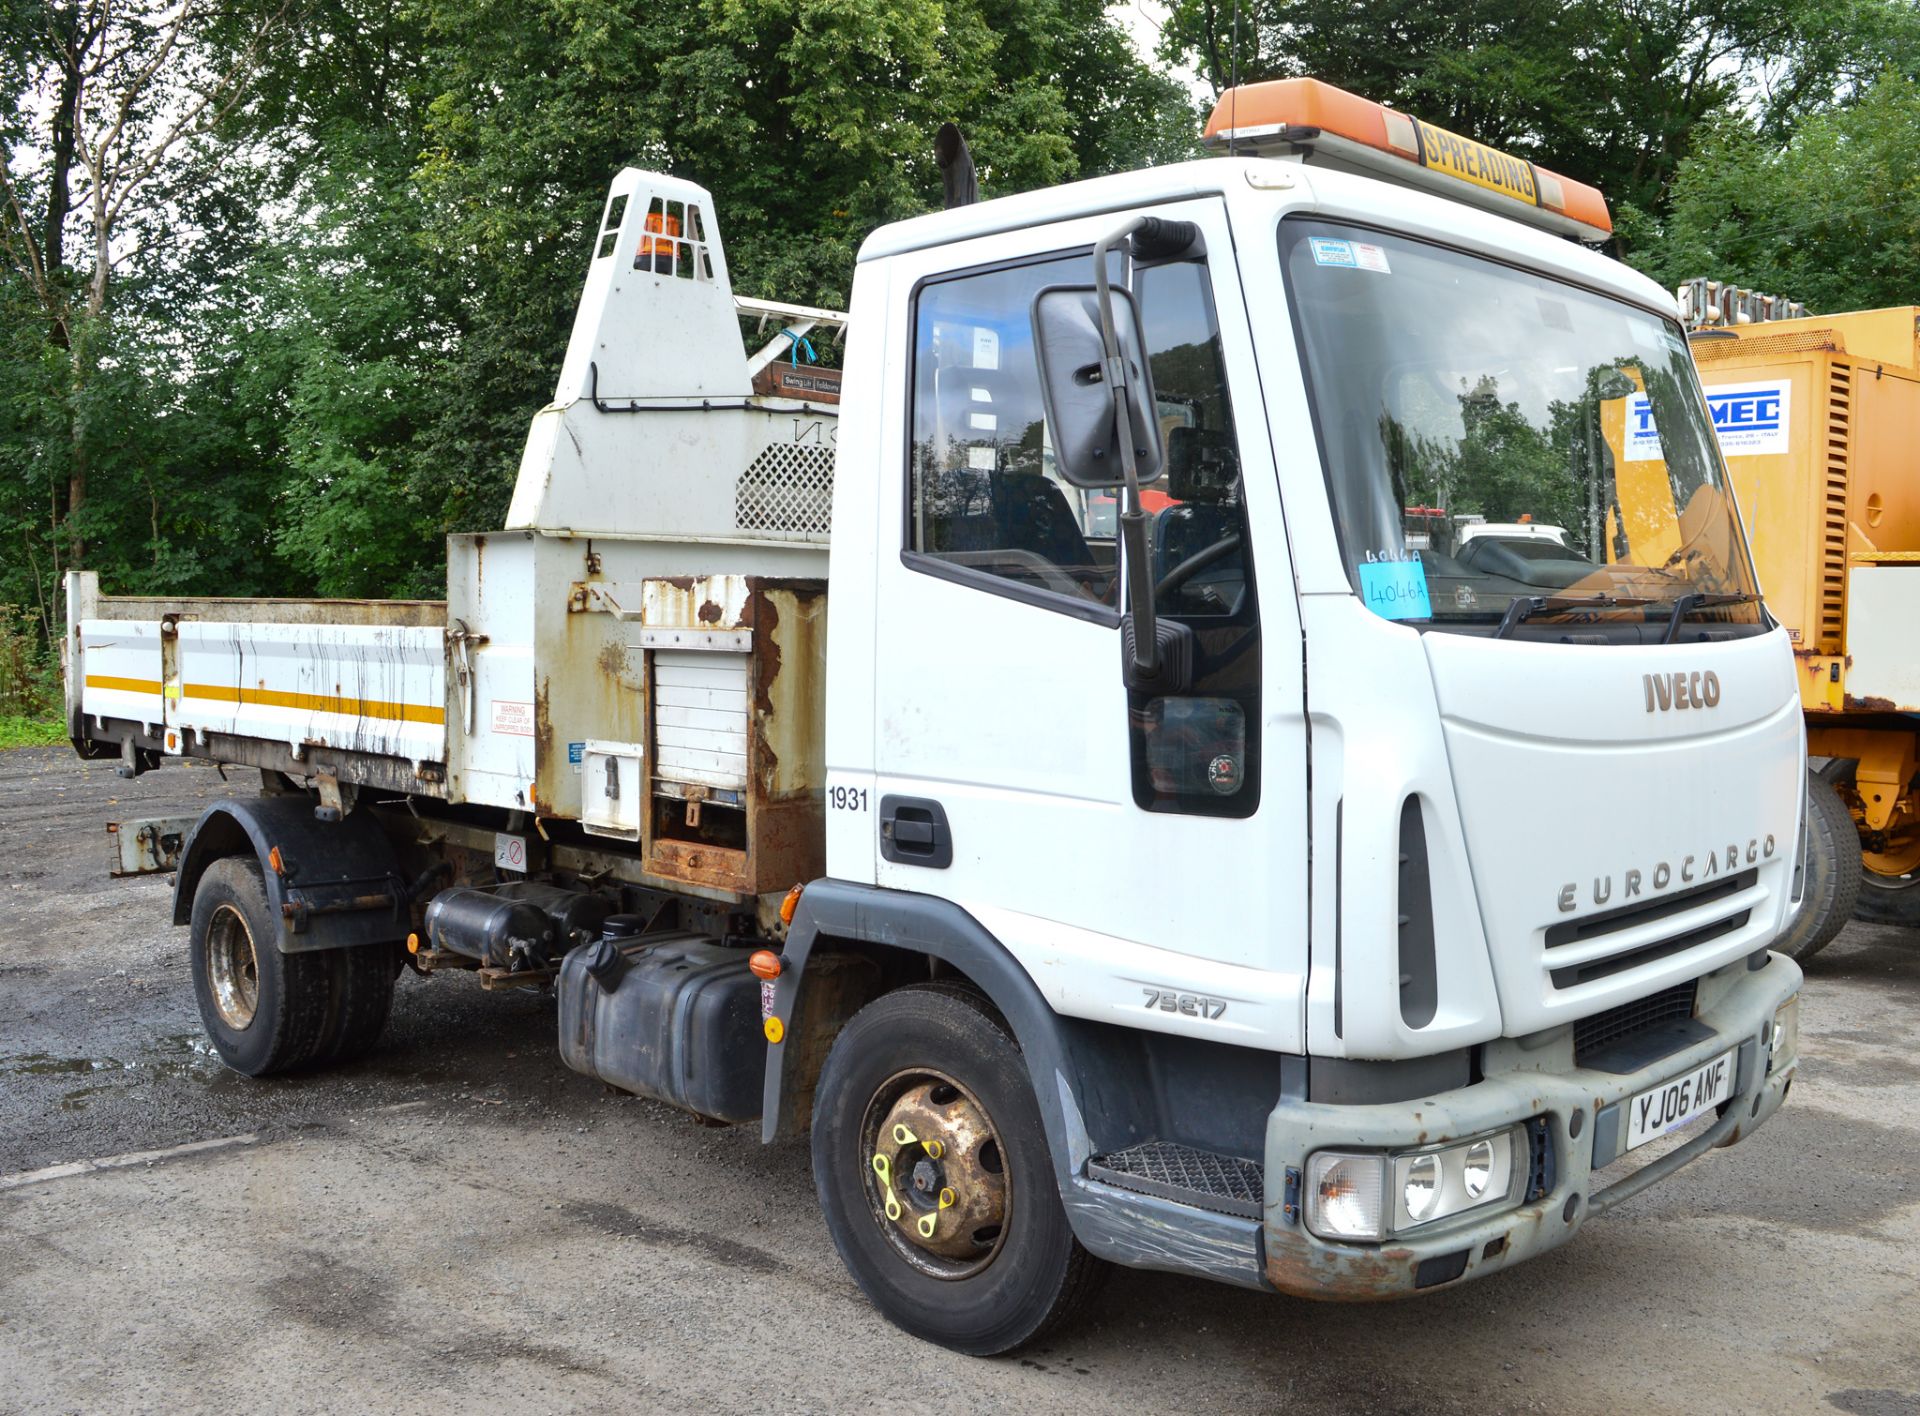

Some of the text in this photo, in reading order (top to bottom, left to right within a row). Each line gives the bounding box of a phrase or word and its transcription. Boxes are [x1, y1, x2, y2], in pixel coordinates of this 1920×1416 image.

[1423, 126, 1535, 198] SPREADING
[1370, 579, 1426, 605] 4046A
[500, 704, 526, 715] WARNING
[1643, 670, 1721, 713] IVECO
[829, 785, 868, 812] 1931
[1557, 834, 1776, 912] EUROCARGO
[1142, 988, 1227, 1020] 75E17
[1640, 1060, 1725, 1134] YJ06 ANF
